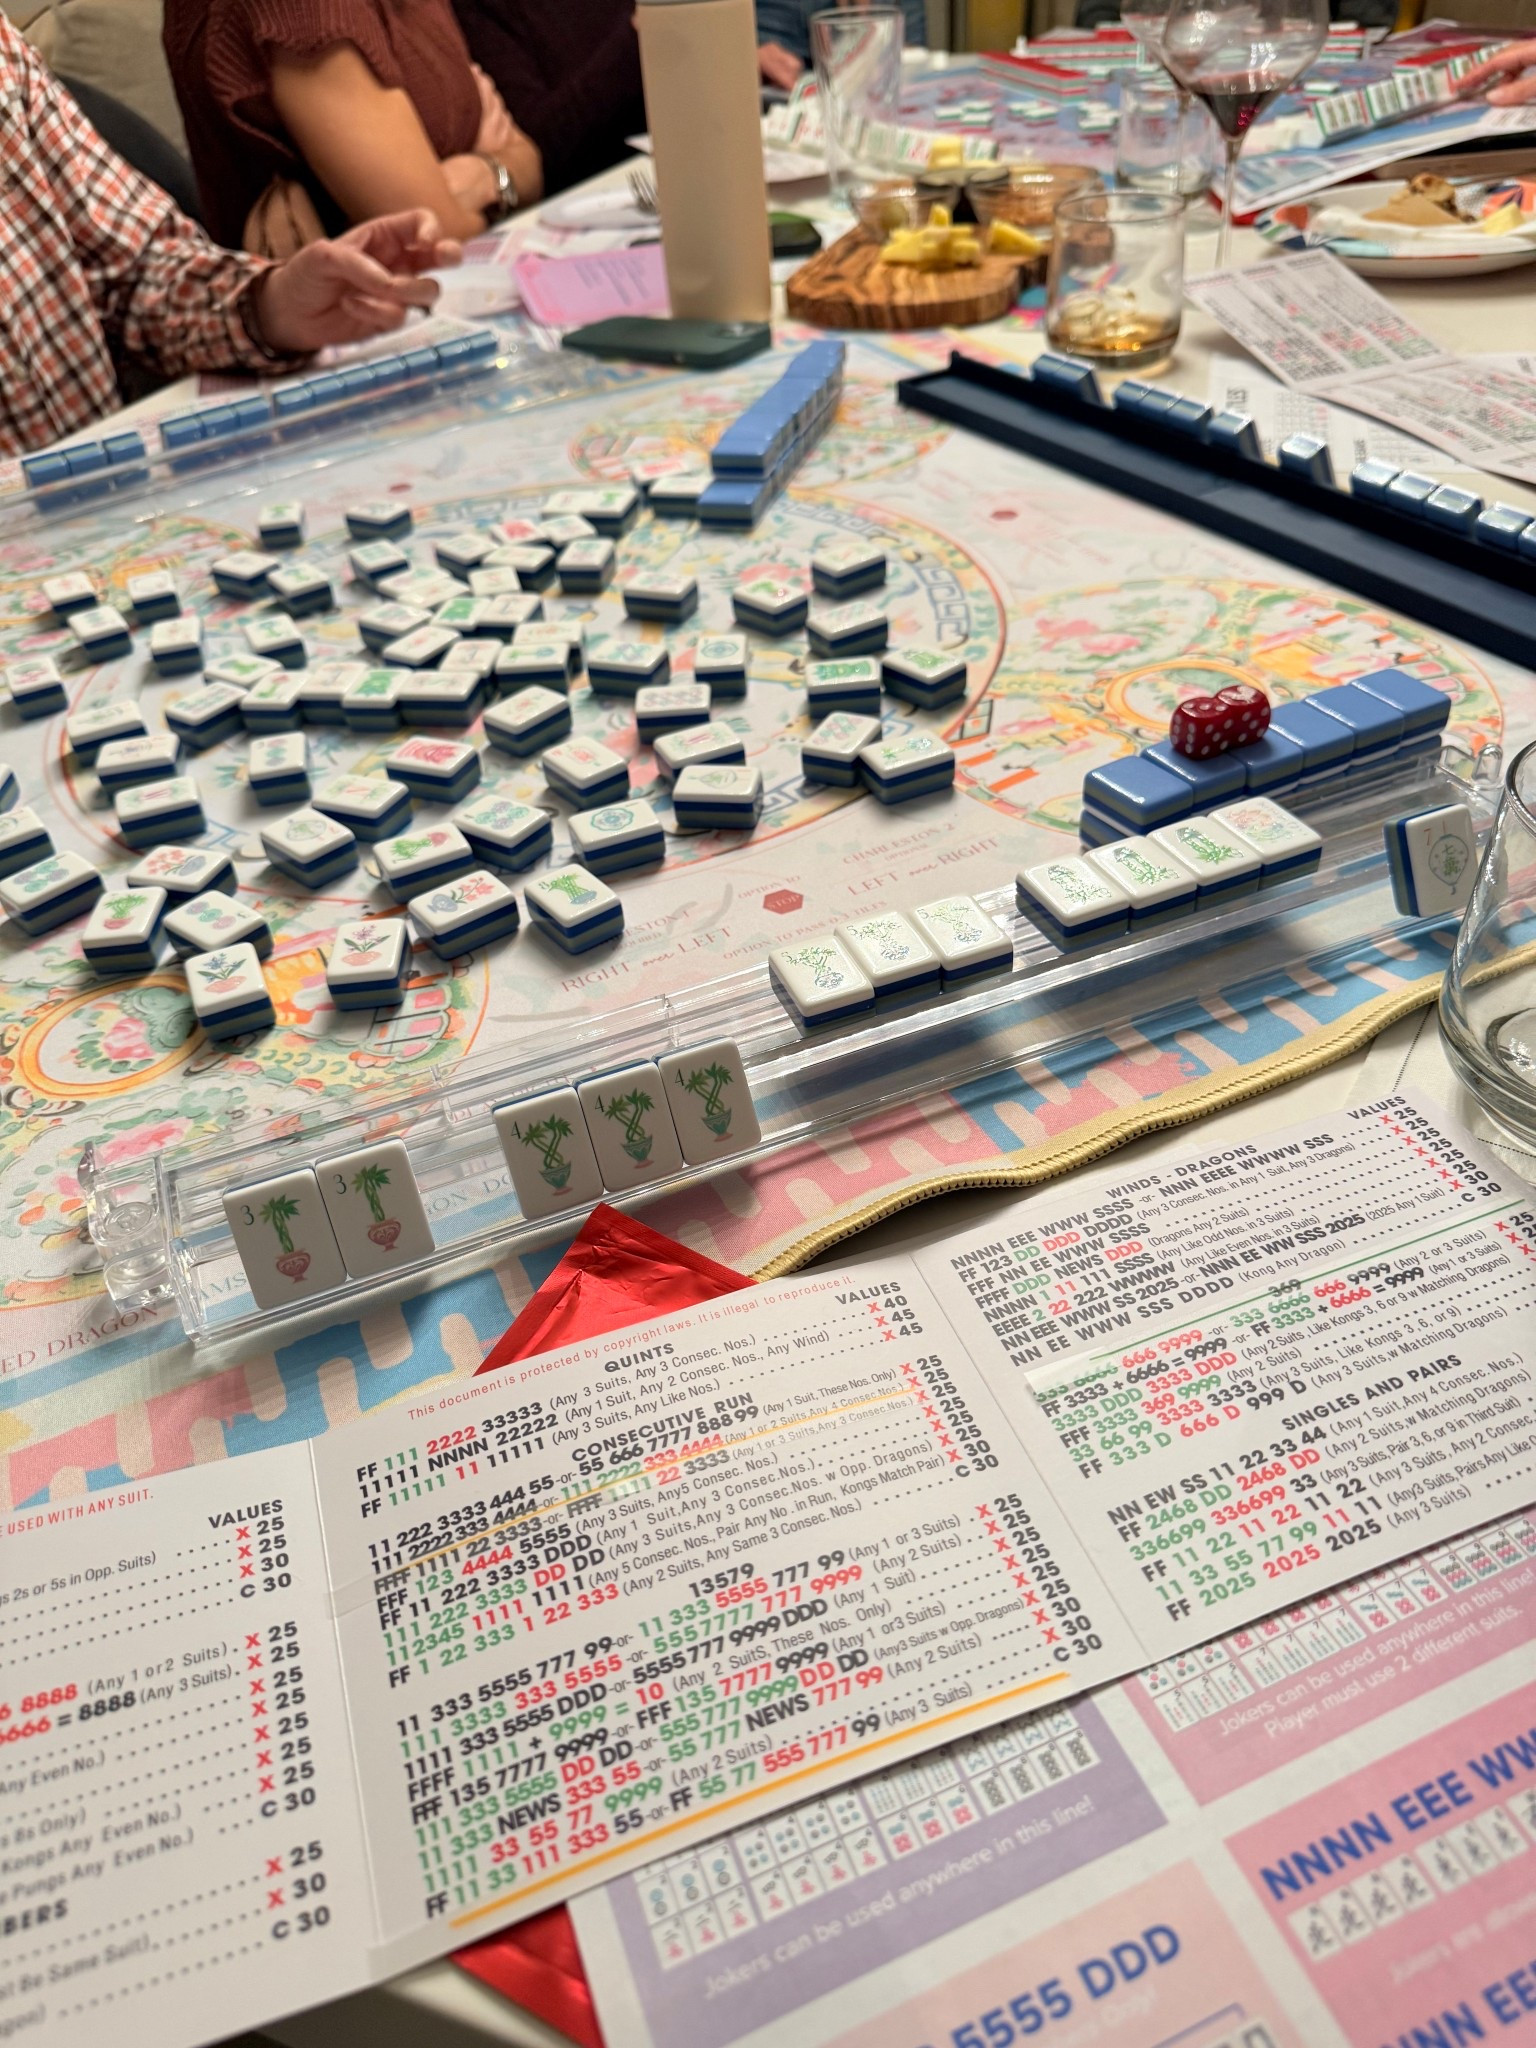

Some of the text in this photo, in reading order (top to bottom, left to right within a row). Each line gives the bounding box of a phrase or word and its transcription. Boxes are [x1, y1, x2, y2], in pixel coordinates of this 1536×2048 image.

[847, 872, 898, 896] LEFT
[937, 837, 998, 866] RIGHT
[561, 961, 629, 992] RIGHT
[678, 926, 731, 954] LEFT
[594, 1095, 605, 1113] 4
[674, 1069, 686, 1087] 4
[1347, 1096, 1406, 1119] VALUES
[511, 1121, 522, 1140] 4
[334, 1173, 347, 1195] 3
[950, 1242, 1005, 1270] NNNN
[1006, 1230, 1038, 1249] EEE
[1037, 1212, 1089, 1237] WWW
[1092, 1198, 1134, 1218] SSSS
[1158, 1177, 1199, 1197] NNN
[1199, 1165, 1237, 1183] EEEE
[1236, 1143, 1301, 1170] WWWW
[1303, 1134, 1334, 1149] SSS
[1379, 1114, 1393, 1124] X
[1393, 1106, 1417, 1120] 25
[1105, 1175, 1161, 1198] WINDS
[1174, 1145, 1257, 1176] DRAGONS
[241, 1205, 254, 1225] 3
[974, 1138, 1452, 1309] FFFF DDD NEWS DDD (Dragons Any 2 Suits) X 25
[834, 1281, 901, 1305] VALUES
[1010, 1182, 1501, 1367] NN EE WWW SSS DDDD (Kong Any Dragon) C 30
[1267, 1278, 1302, 1298] 369
[0, 1305, 157, 1376] ED DRAGON
[407, 1276, 855, 1420] This document is protected by copyright laws. It is illegal to reproduce it.
[604, 1343, 674, 1372] QUINTS
[356, 1295, 907, 1482] FF 111 2222 33333 (Any 3 Suits, Any 3 Consec. Nos.) X 40
[1281, 1354, 1461, 1430] SINGLES AND PAIRS
[571, 1392, 753, 1461] CONSECUTIVE RUN
[7, 1488, 153, 1535] USED WITH ANY SUIT.
[208, 1499, 283, 1528] VALUES
[377, 1588, 407, 1614] FFF
[415, 1569, 454, 1595] 123
[462, 1545, 513, 1575] 4444
[520, 1523, 571, 1554] 5555
[576, 1515, 605, 1534] (Any
[608, 1508, 617, 1521] 3
[618, 1498, 654, 1517] Suits,
[693, 1467, 743, 1490] Consec.
[745, 1451, 778, 1472] Nos.)
[922, 1405, 938, 1418] X
[940, 1396, 965, 1413] 25
[13, 1516, 284, 1601] 2s or 5s in Opp. Suits) X 25
[240, 1572, 291, 1598] C 30
[688, 1563, 754, 1598] 13579
[1166, 1484, 1471, 1621] FF 2025 2025 2025 (Any 3 Suits)
[1218, 1568, 1535, 1737] Jokers can be used anywhere in this line!
[424, 1615, 1092, 1893] 1111 33 55 77 9999 (Any 2 Suits) X 30
[1259, 1811, 1392, 1902] NNNN
[1390, 1770, 1474, 1833] EEE
[1076, 1923, 1181, 2001] DDD
